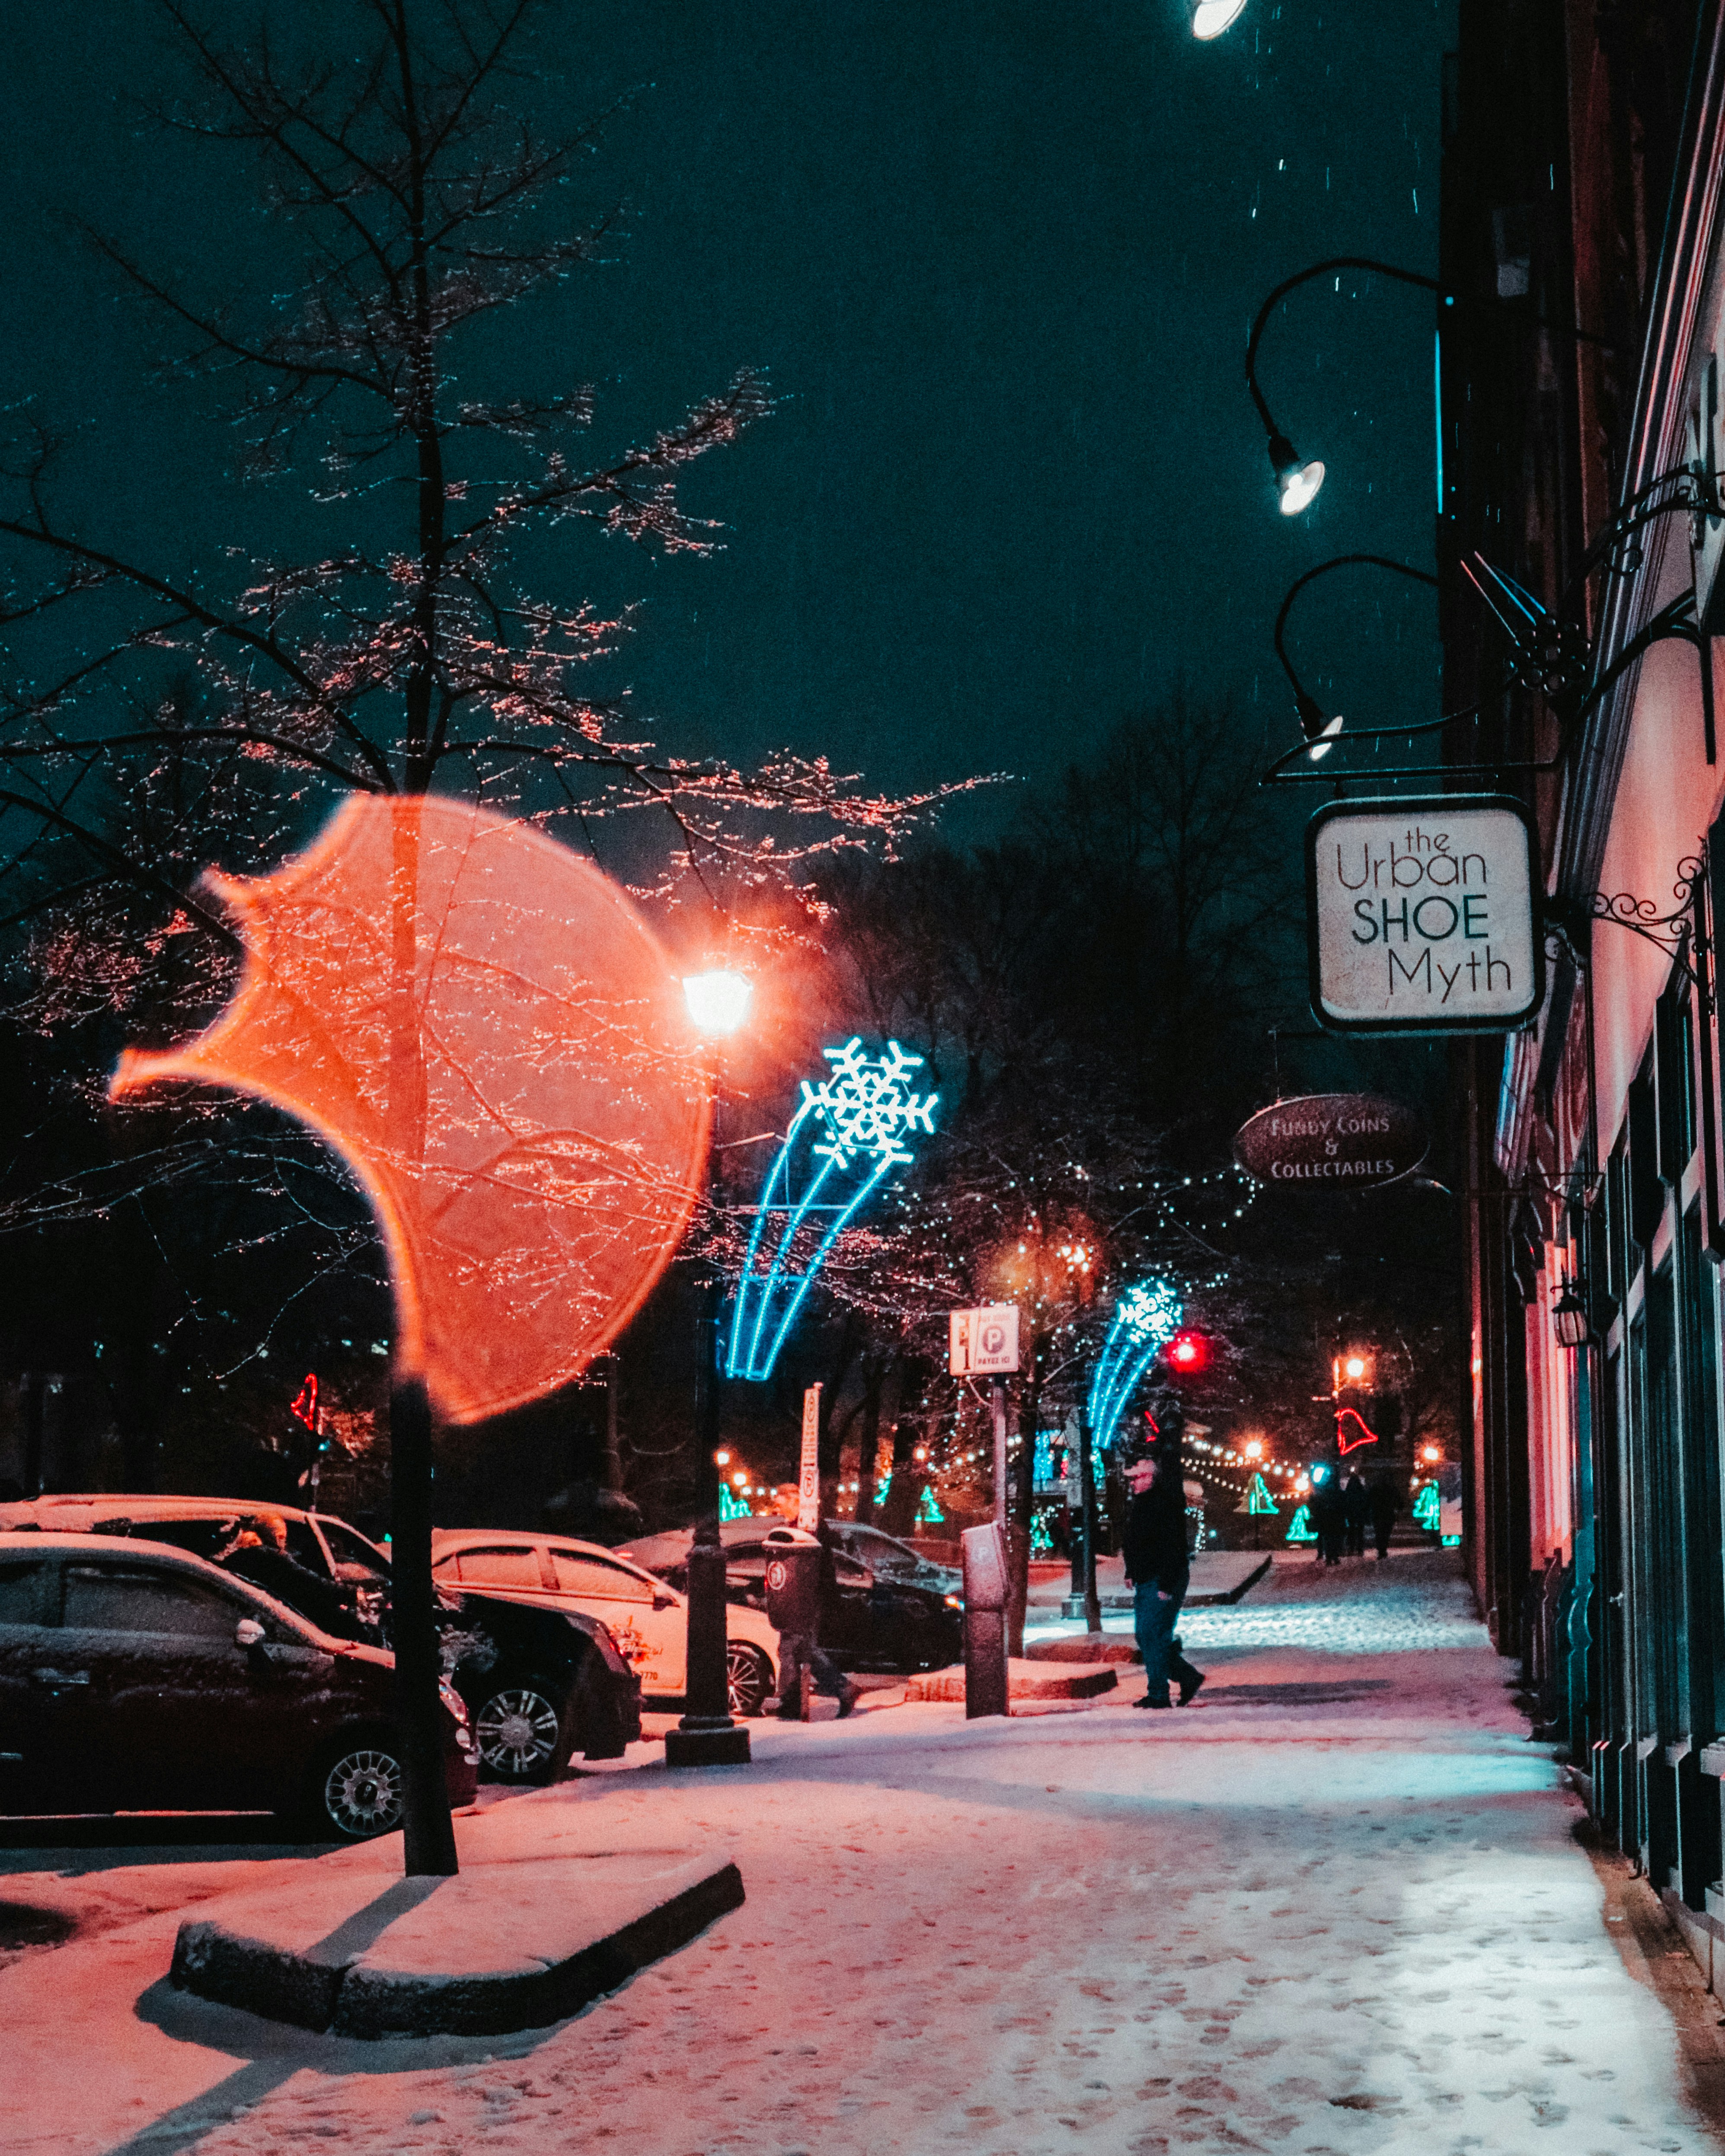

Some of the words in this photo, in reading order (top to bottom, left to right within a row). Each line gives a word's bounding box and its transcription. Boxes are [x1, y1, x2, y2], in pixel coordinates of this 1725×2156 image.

[1405, 827, 1450, 852] the
[1337, 842, 1487, 890] Urban
[1352, 894, 1489, 944] SHOE
[1388, 945, 1511, 1003] Myth
[1337, 1116, 1390, 1135] COINS
[1325, 1138, 1338, 1156] &
[1271, 1159, 1394, 1178] COLLECTABLES
